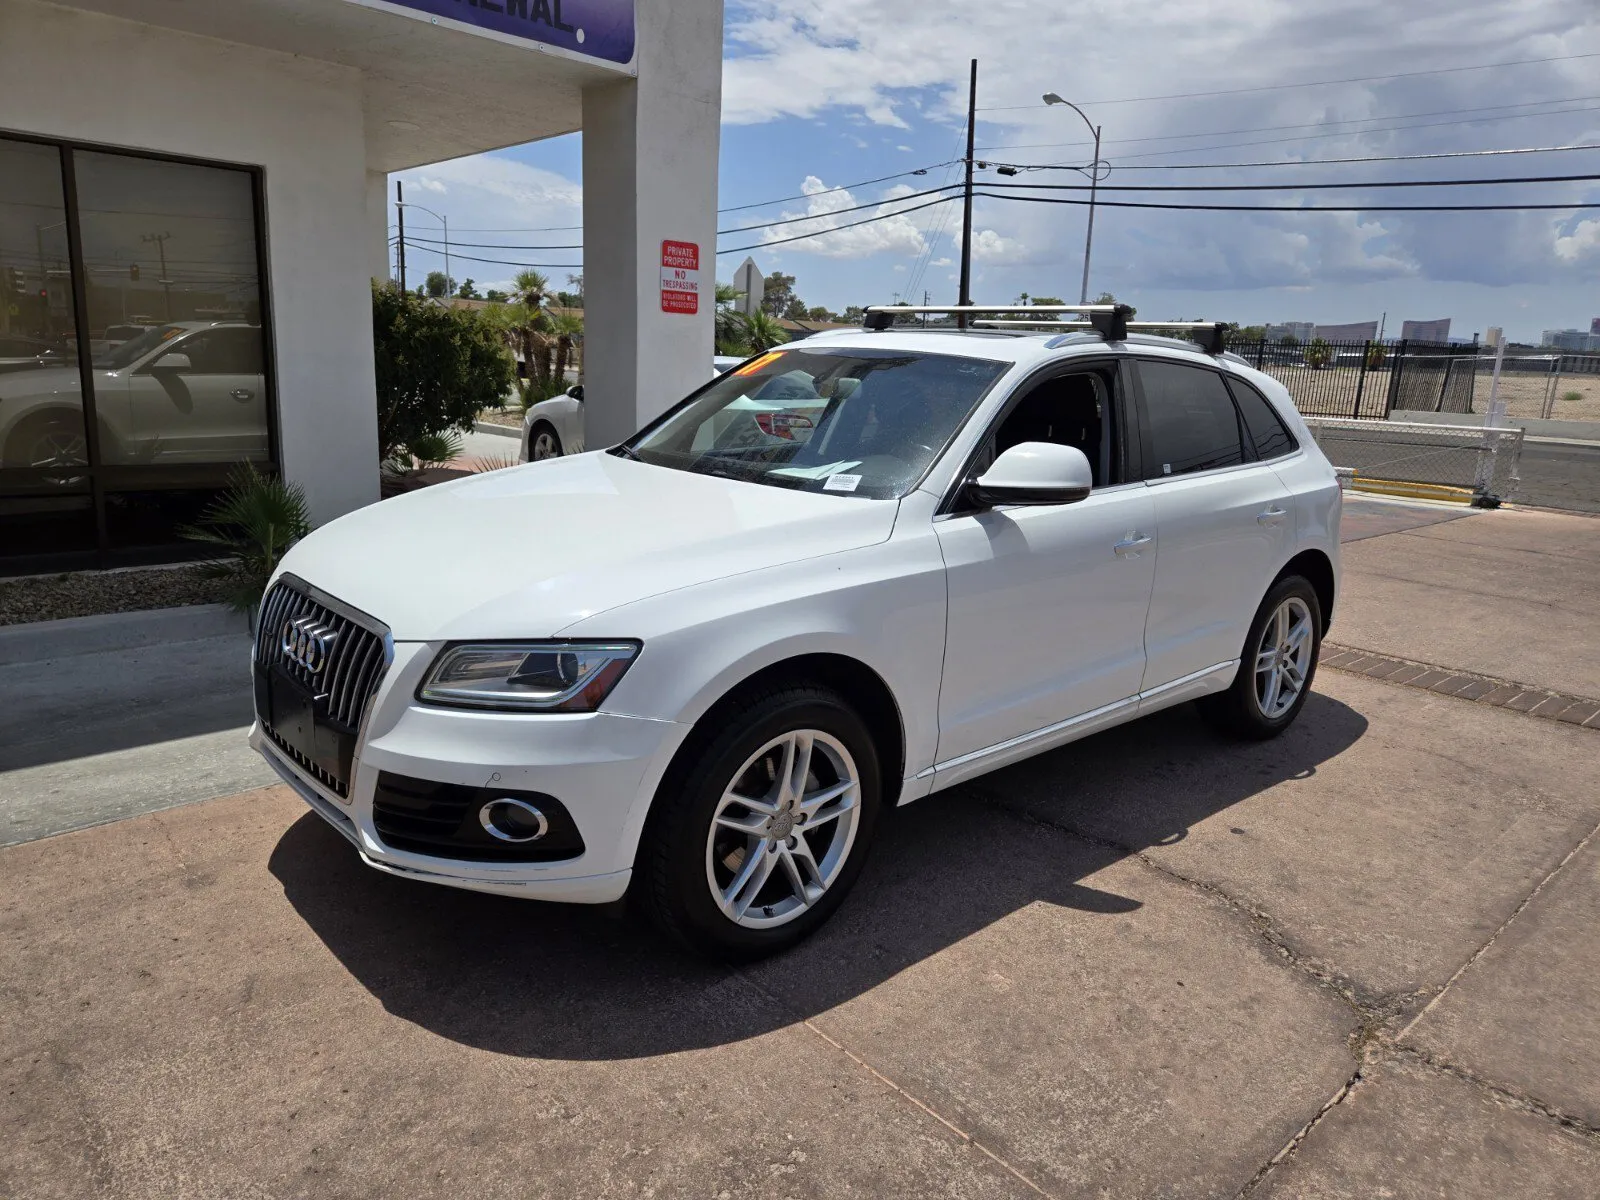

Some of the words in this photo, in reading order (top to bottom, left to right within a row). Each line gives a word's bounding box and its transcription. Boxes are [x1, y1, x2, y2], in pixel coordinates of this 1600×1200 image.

[668, 246, 693, 257] PRIVATE
[664, 256, 696, 268] PROPERTY
[675, 270, 686, 279] NO
[663, 280, 697, 290] TRESPASSING
[1080, 313, 1088, 322] 25
